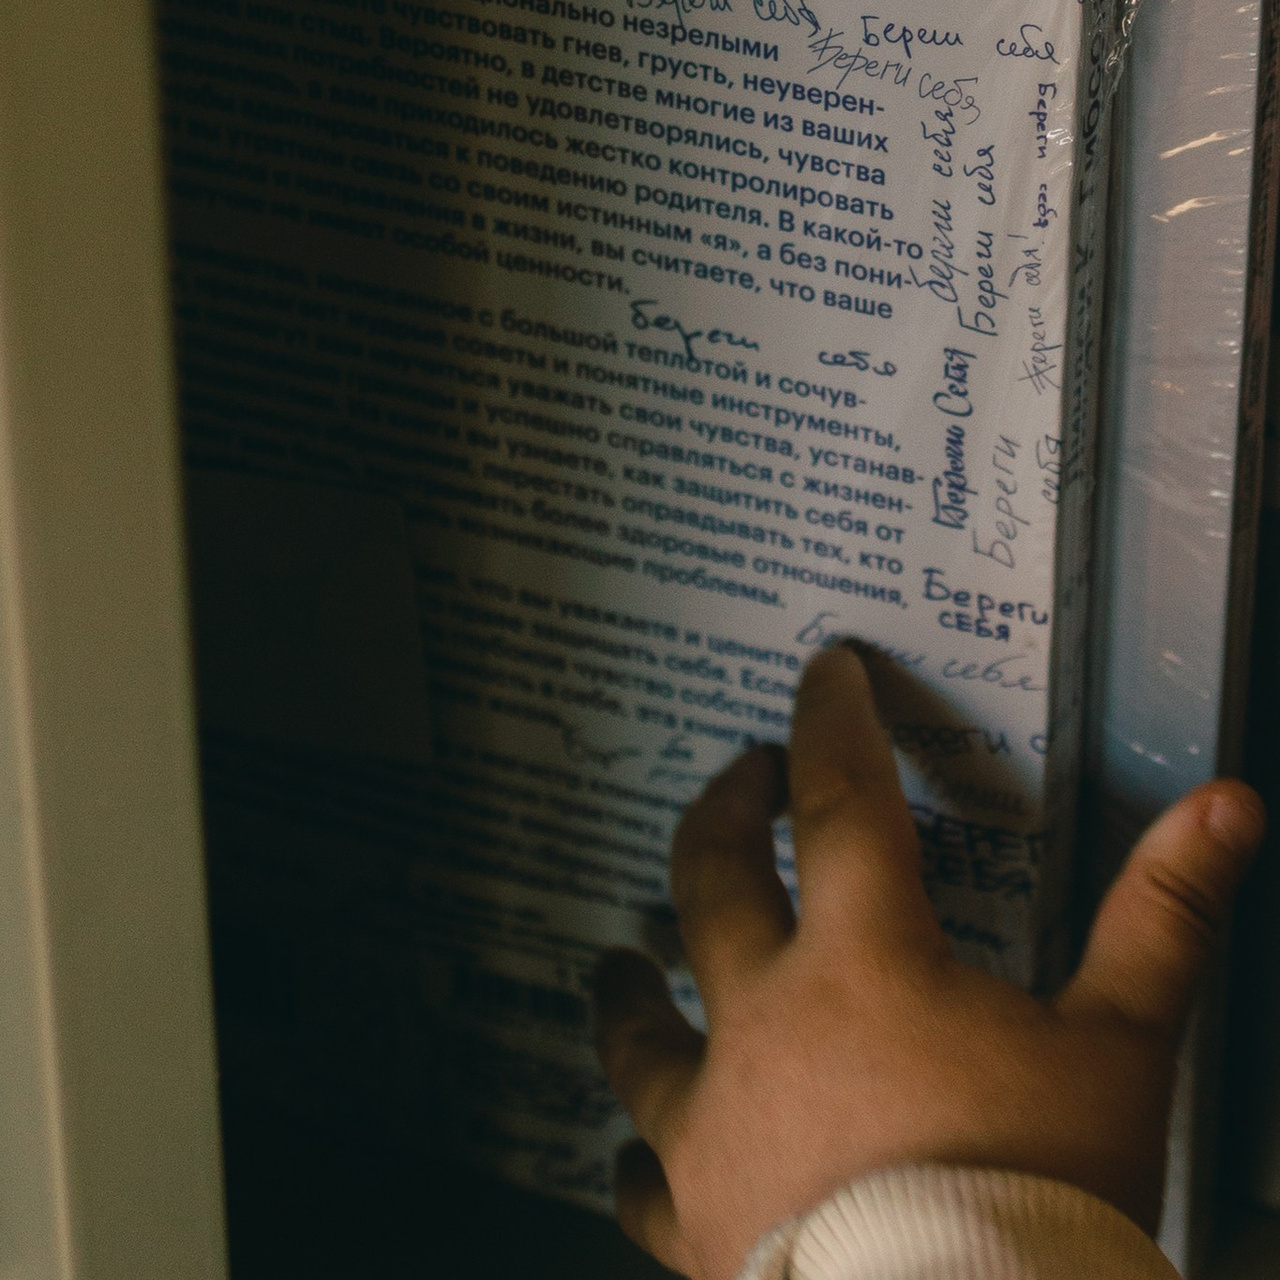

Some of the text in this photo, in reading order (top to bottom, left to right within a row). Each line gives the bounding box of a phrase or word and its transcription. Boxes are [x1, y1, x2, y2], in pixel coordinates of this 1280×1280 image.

[562, 33, 628, 68] гнев,
[637, 48, 735, 90] грусть,
[742, 69, 884, 114] неуверен-
[621, 11, 778, 61] незрелыми
[861, 15, 1061, 65] Береги себя
[376, 23, 513, 79] Вероятно,
[520, 59, 535, 80] в
[540, 63, 647, 103] детстве
[654, 86, 755, 125] многие
[762, 109, 793, 133] из
[802, 117, 887, 152] ваших
[485, 85, 517, 109] не
[525, 93, 768, 165] удовлетворялись,
[778, 145, 885, 186] чувства
[384, 97, 558, 150] приходилось
[564, 134, 661, 172] жестко
[668, 156, 892, 221] контролировать
[454, 143, 469, 164] к
[475, 147, 626, 198] поведению
[633, 181, 769, 228] родителя.
[778, 206, 794, 233] В
[802, 217, 922, 260] какой-то
[427, 171, 460, 194] со
[465, 179, 550, 214] своим
[556, 198, 692, 244] истинным
[699, 229, 748, 260] «я»,
[756, 241, 770, 261] а
[779, 240, 825, 272] без
[834, 257, 911, 288] пони-
[490, 216, 582, 256] жизни,
[590, 237, 624, 261] вы
[631, 246, 762, 294] считаете,
[769, 276, 815, 302] что
[823, 287, 892, 319] ваше
[494, 249, 629, 293] ценности.
[957, 145, 1009, 337] Береги себя
[477, 308, 494, 327] с
[499, 308, 618, 355] большой
[625, 340, 746, 383] теплотой
[754, 369, 770, 389] и
[778, 374, 866, 410] сочув-
[552, 356, 569, 375] и
[574, 361, 704, 406] понятные
[710, 391, 900, 453] инструменты,
[506, 377, 611, 416] уважать
[618, 402, 682, 432] свои
[689, 418, 800, 461] чувства,
[808, 445, 924, 484] устанав-
[606, 430, 772, 483] справляться
[779, 469, 794, 488] с
[802, 474, 912, 513] жизнен-
[621, 494, 794, 550] оправдывать
[802, 536, 850, 566] тех,
[859, 550, 902, 575] кто
[622, 465, 664, 489] как
[672, 476, 798, 520] защитить
[805, 507, 867, 536] себя
[875, 523, 904, 544] от
[972, 435, 1030, 569] Береги
[752, 555, 908, 609] отношения,
[922, 568, 1048, 625] Береги
[938, 611, 1010, 641] СЕБЯ
